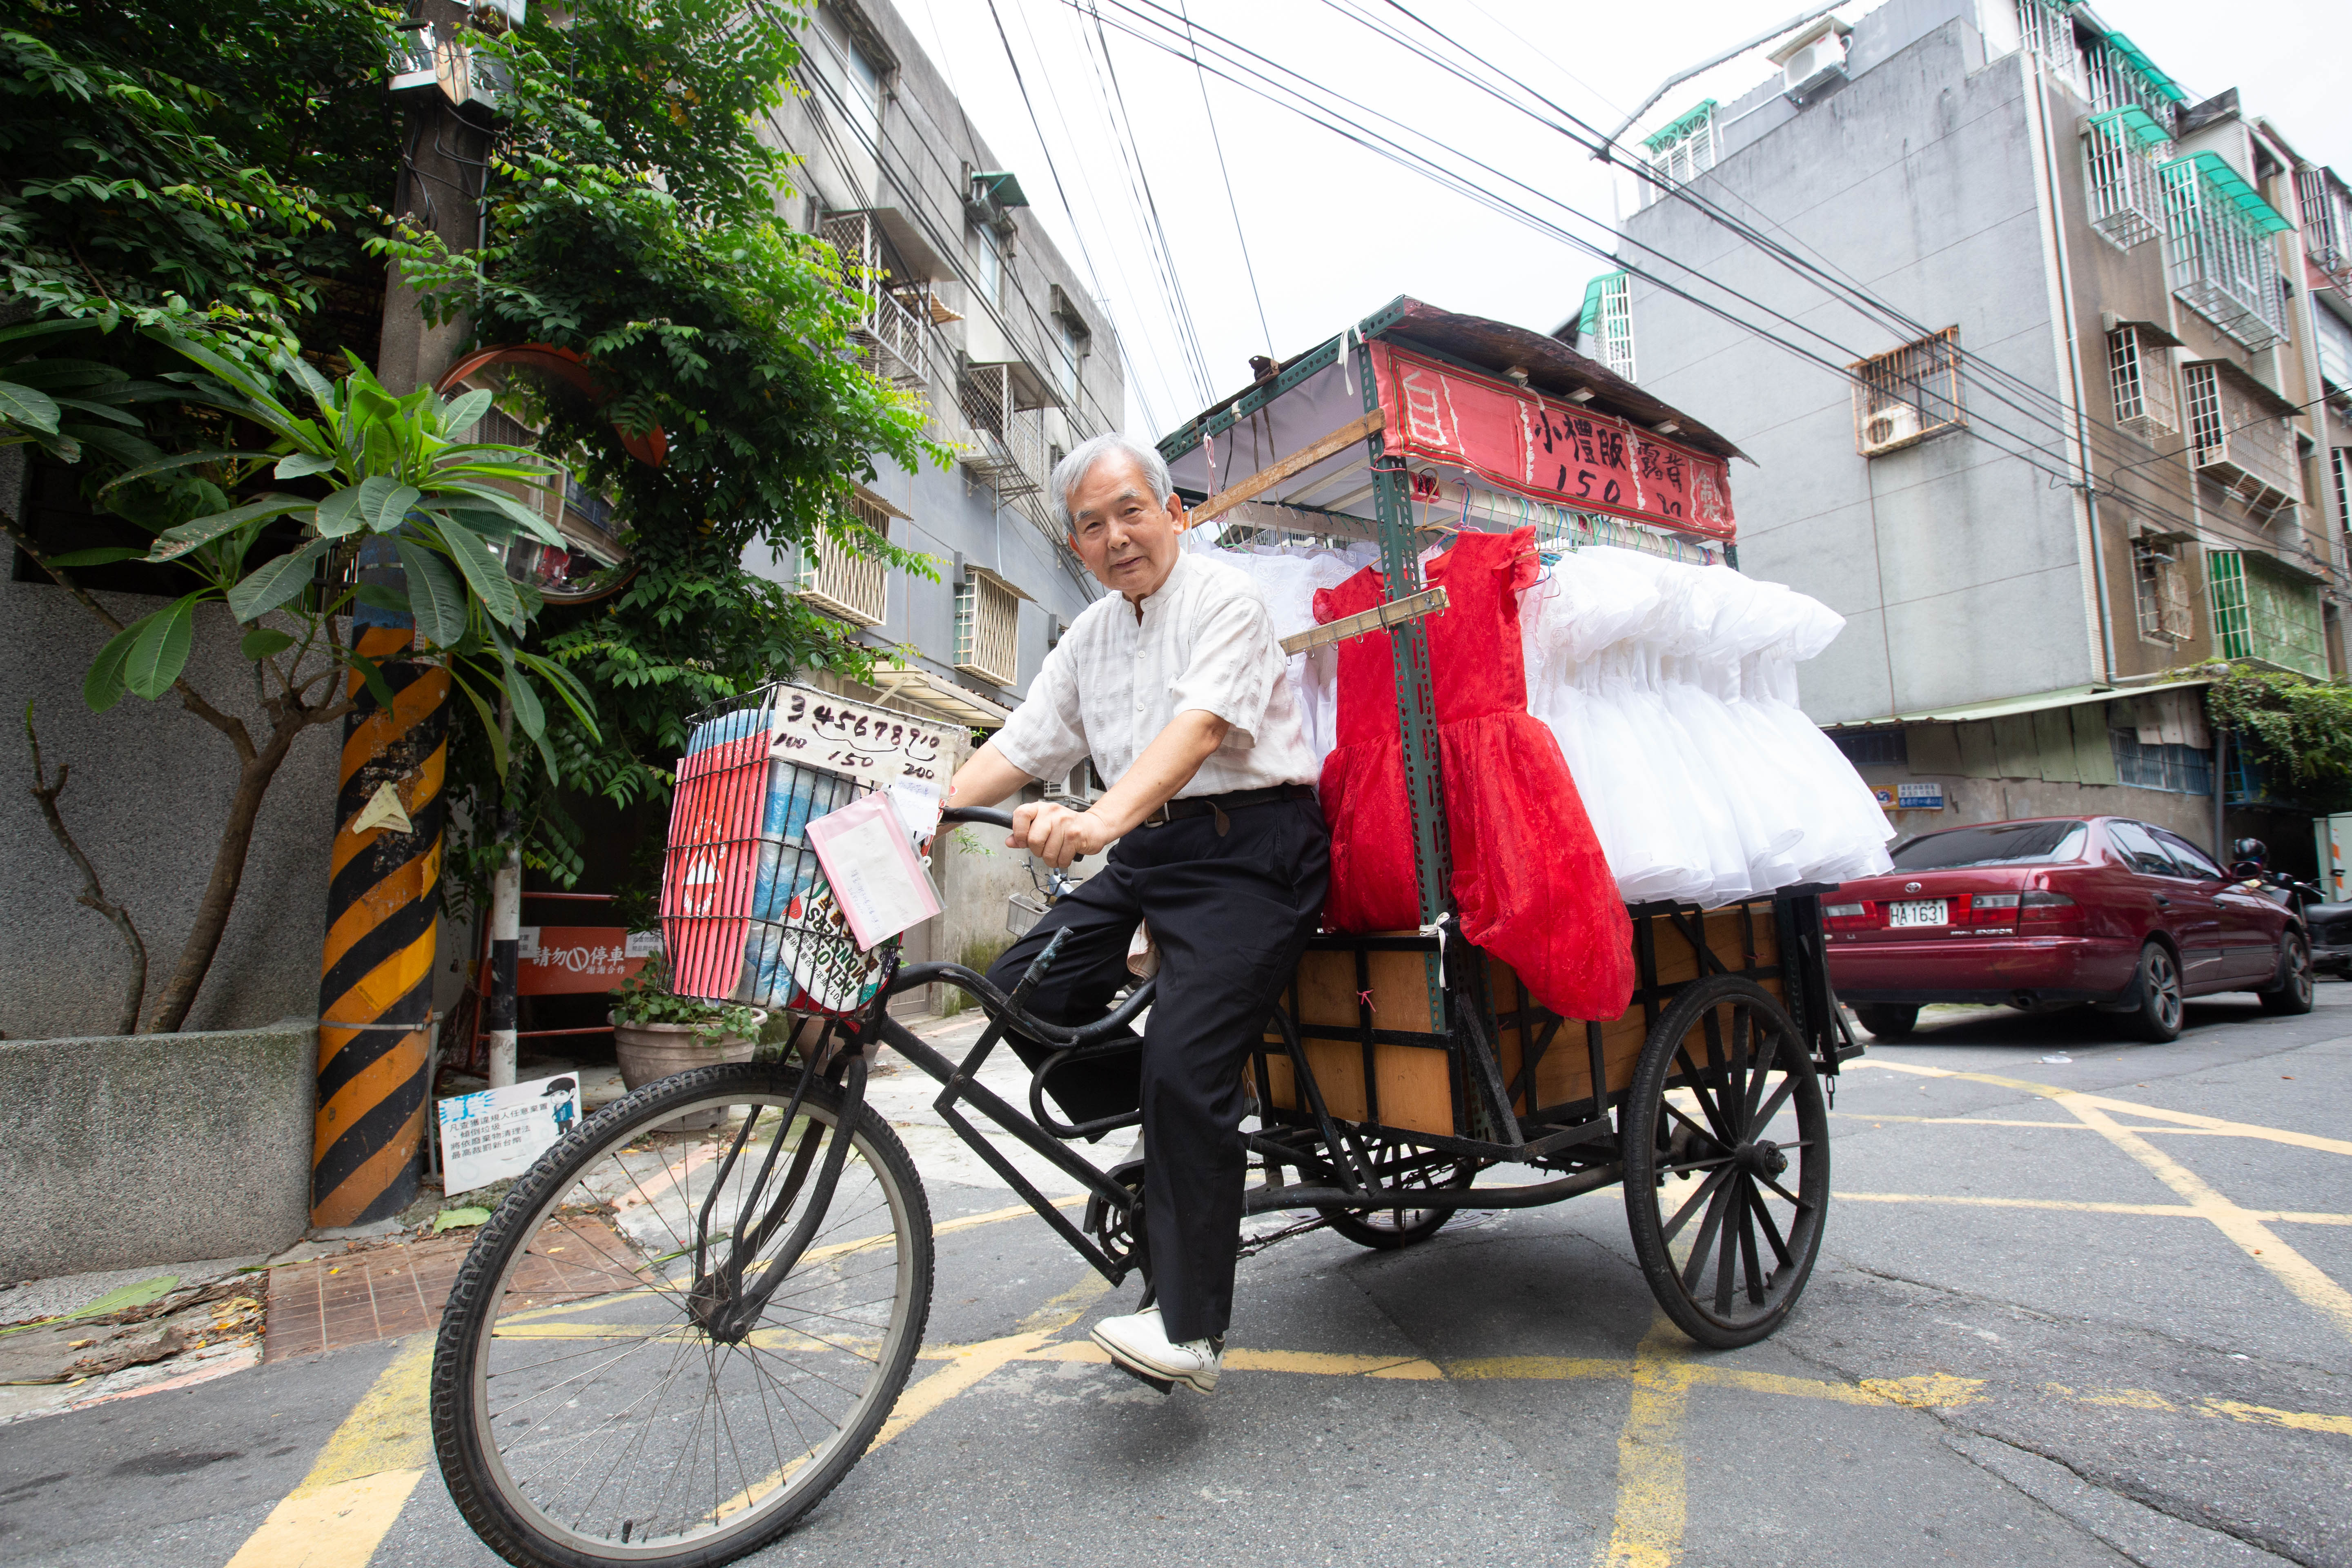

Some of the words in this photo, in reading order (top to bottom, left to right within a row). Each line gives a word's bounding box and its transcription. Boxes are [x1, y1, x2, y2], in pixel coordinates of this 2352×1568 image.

[1535, 410, 1627, 471] 小禮服
[1638, 442, 1685, 493] 露背
[1557, 464, 1620, 503] 150
[773, 733, 807, 749] 100
[828, 751, 873, 767] 150
[532, 946, 568, 967] 請勿
[590, 945, 624, 966] 停車
[807, 908, 869, 985] MONSTERS
[586, 965, 626, 975] 謝謝合作
[812, 944, 856, 997] HELLO!
[450, 1125, 530, 1151] 將依廢棄物清理法
